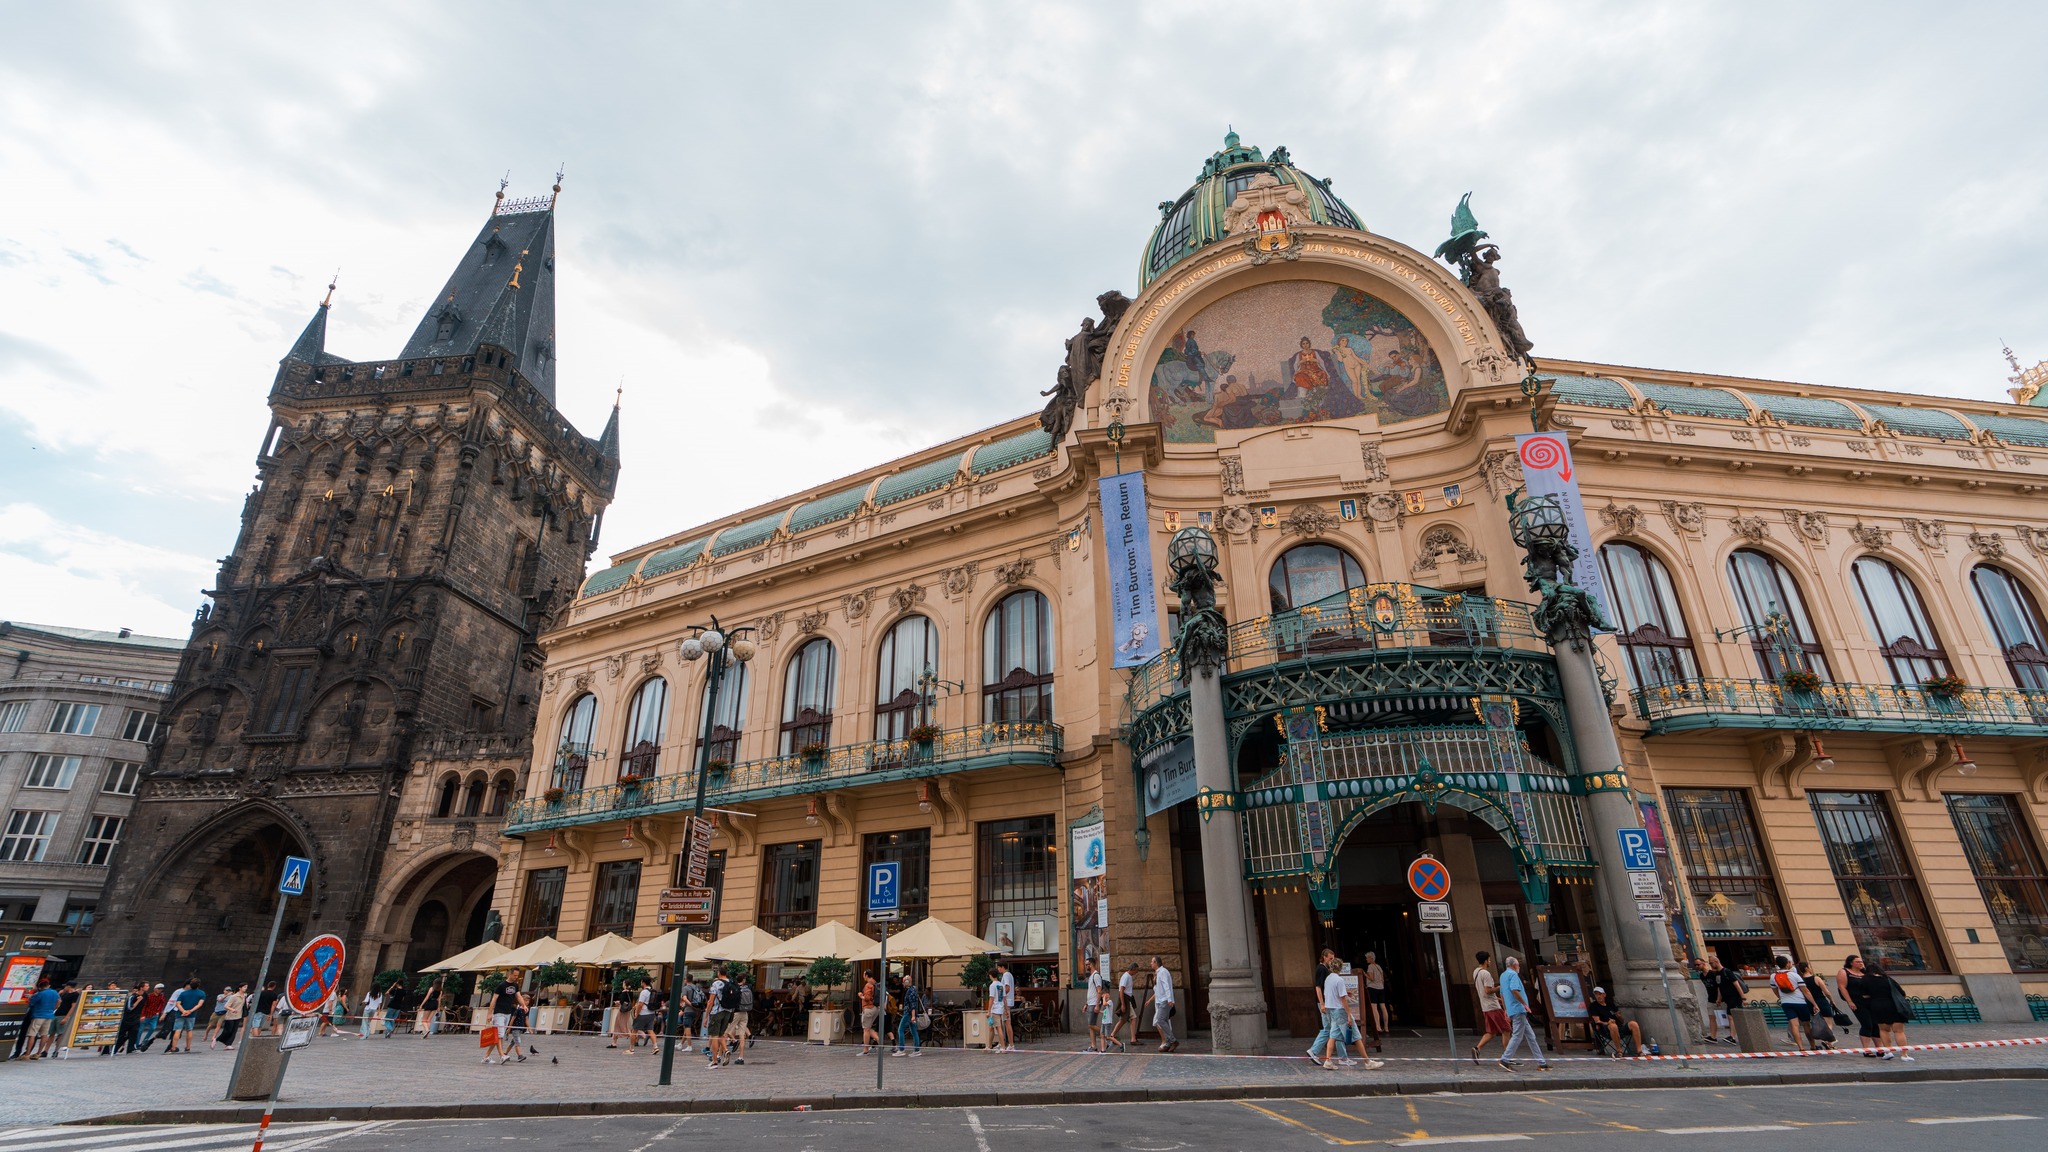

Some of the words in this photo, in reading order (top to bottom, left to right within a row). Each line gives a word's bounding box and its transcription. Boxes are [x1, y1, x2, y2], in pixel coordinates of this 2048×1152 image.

[1306, 243, 1328, 252] JAK
[1331, 246, 1388, 267] ODOLALAS
[1117, 363, 1131, 388] ZDAR
[1119, 482, 1132, 521] Return
[1562, 491, 1575, 528] RETURN
[1124, 523, 1134, 546] The
[1128, 547, 1140, 593] Burton:
[1583, 548, 1598, 586] 30/9/24
[1130, 594, 1142, 619] Tim
[1163, 768, 1178, 783] Tim
[1178, 758, 1196, 776] Burt
[1625, 834, 1643, 856] P
[875, 869, 892, 895] P
